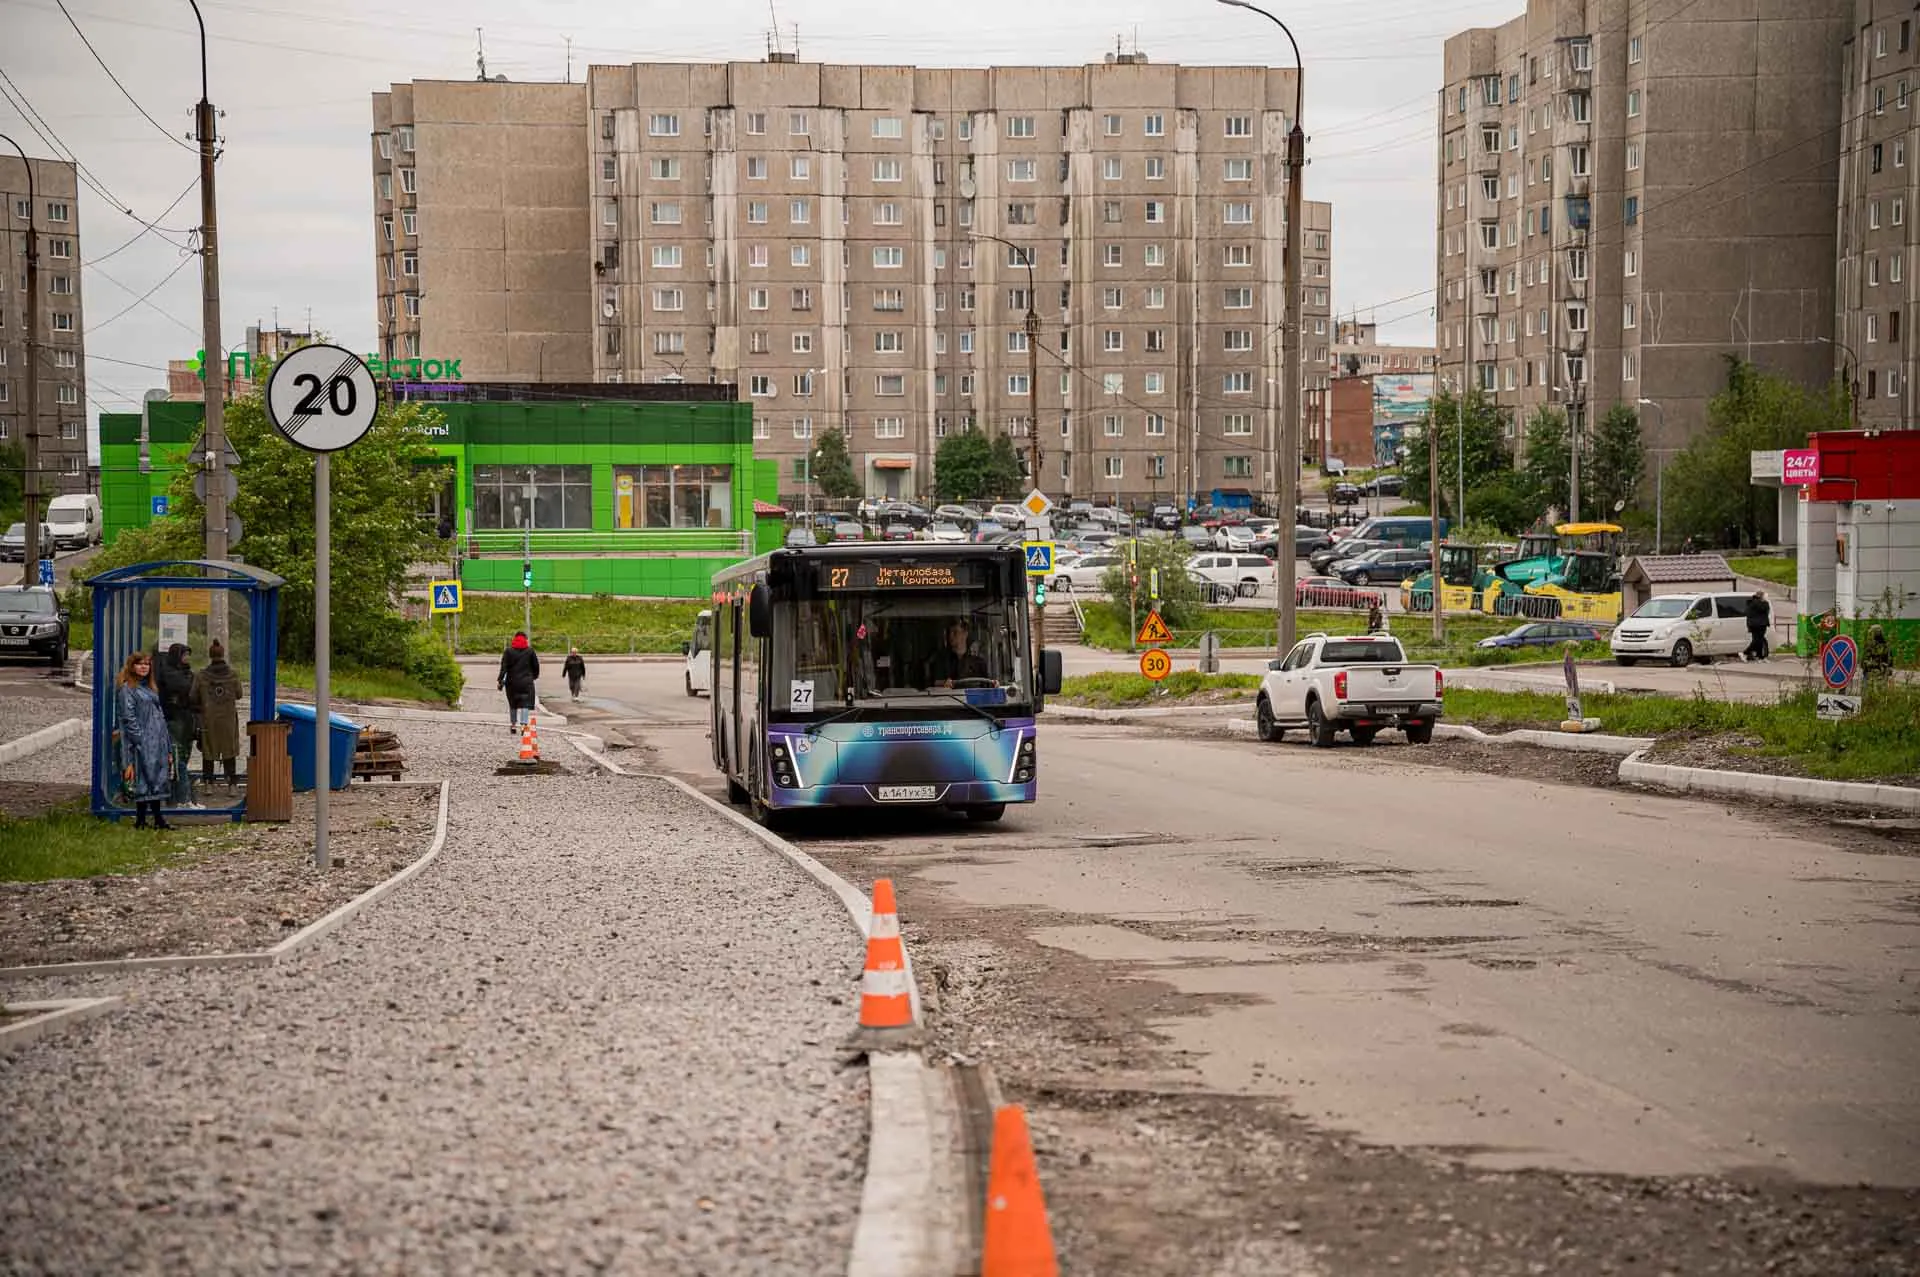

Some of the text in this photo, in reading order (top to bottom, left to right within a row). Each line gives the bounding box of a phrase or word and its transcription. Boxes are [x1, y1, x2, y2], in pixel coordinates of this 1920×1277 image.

[292, 373, 357, 417] 20
[1786, 456, 1816, 467] 24/7
[1786, 468, 1816, 477] ЦВЕТЫ
[831, 568, 849, 587] 27
[879, 567, 952, 577] Металлобаза
[876, 576, 955, 586] Ул. Крупской
[1147, 658, 1165, 671] 30
[793, 689, 812, 703] 27
